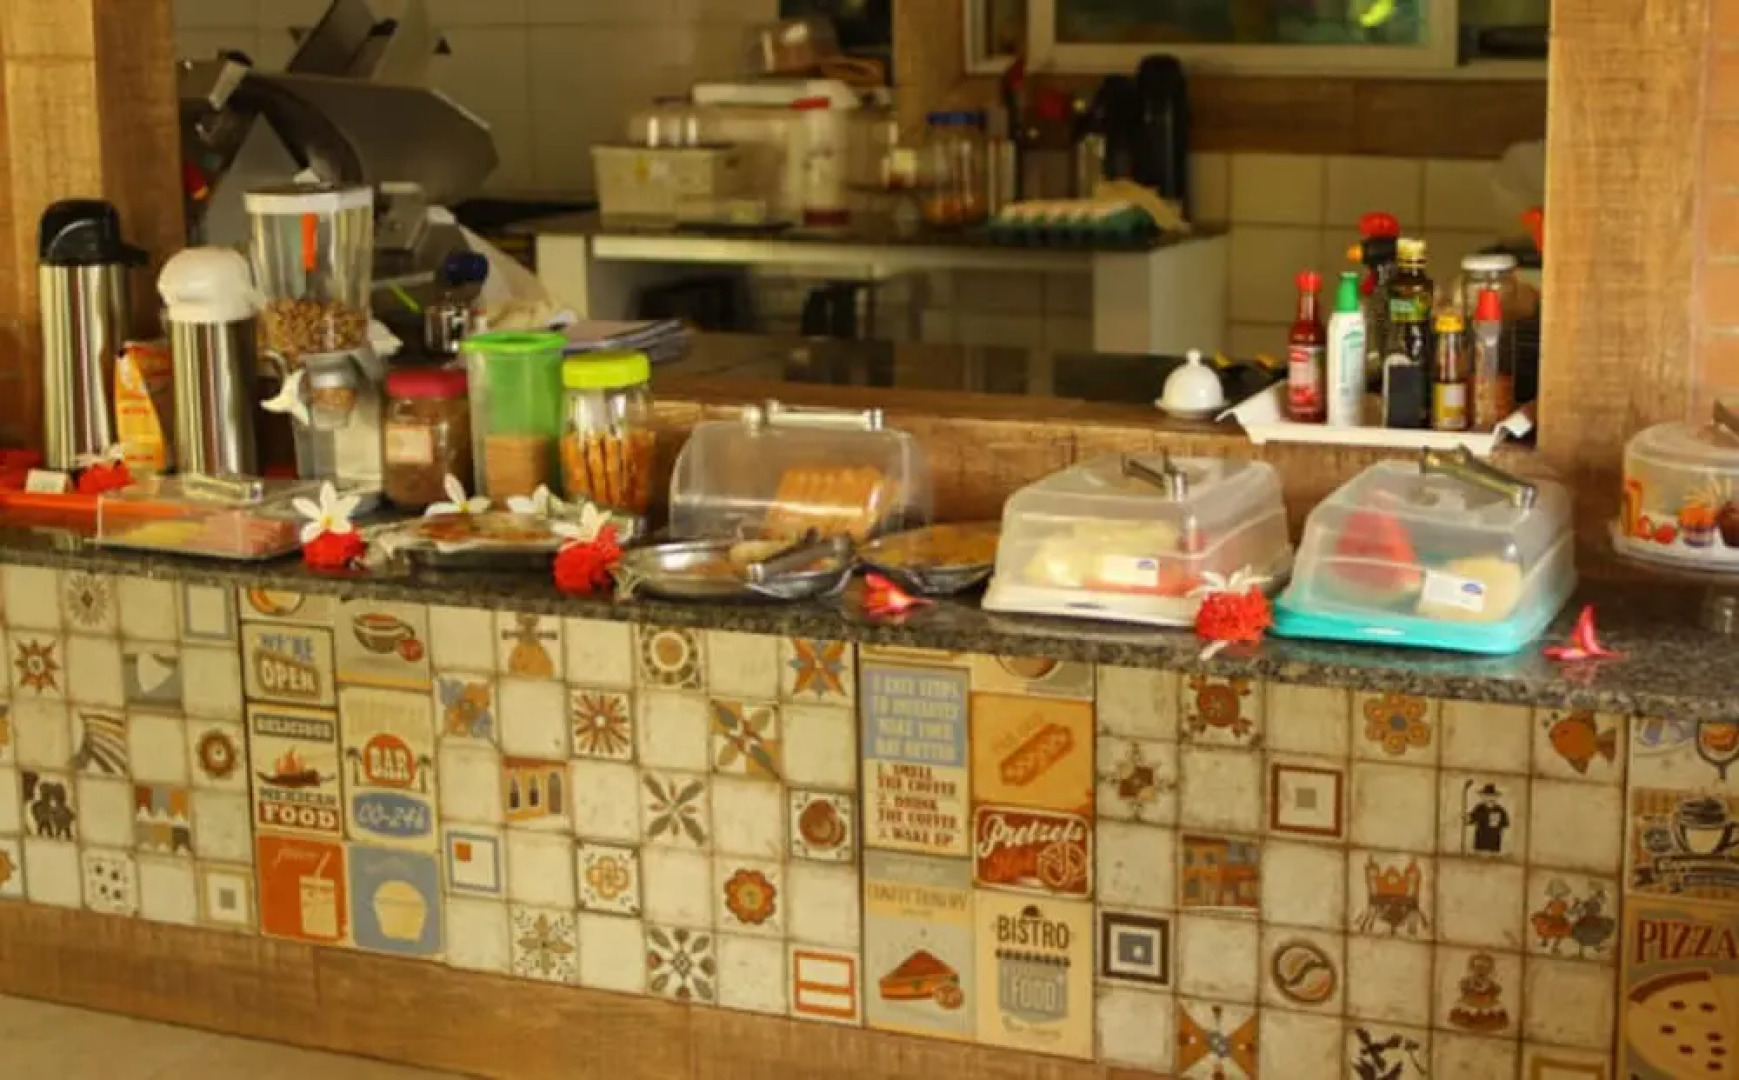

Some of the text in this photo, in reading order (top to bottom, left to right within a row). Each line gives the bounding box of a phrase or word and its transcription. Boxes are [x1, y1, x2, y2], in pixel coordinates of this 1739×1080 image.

[262, 658, 315, 692] OPEN
[370, 747, 410, 780] BAR
[893, 765, 932, 780] SMELL
[877, 776, 901, 789] THE
[260, 787, 336, 804] MEXICAN
[894, 796, 936, 811] DRINK
[264, 804, 335, 828] FOOD
[877, 809, 901, 822] THE
[892, 828, 929, 844] WAKE
[934, 832, 953, 846] UP
[978, 814, 1084, 858] Pretzels
[997, 915, 1070, 949] BISTRO
[1637, 919, 1739, 963] PIZZA
[1012, 974, 1056, 1012] FOOD
